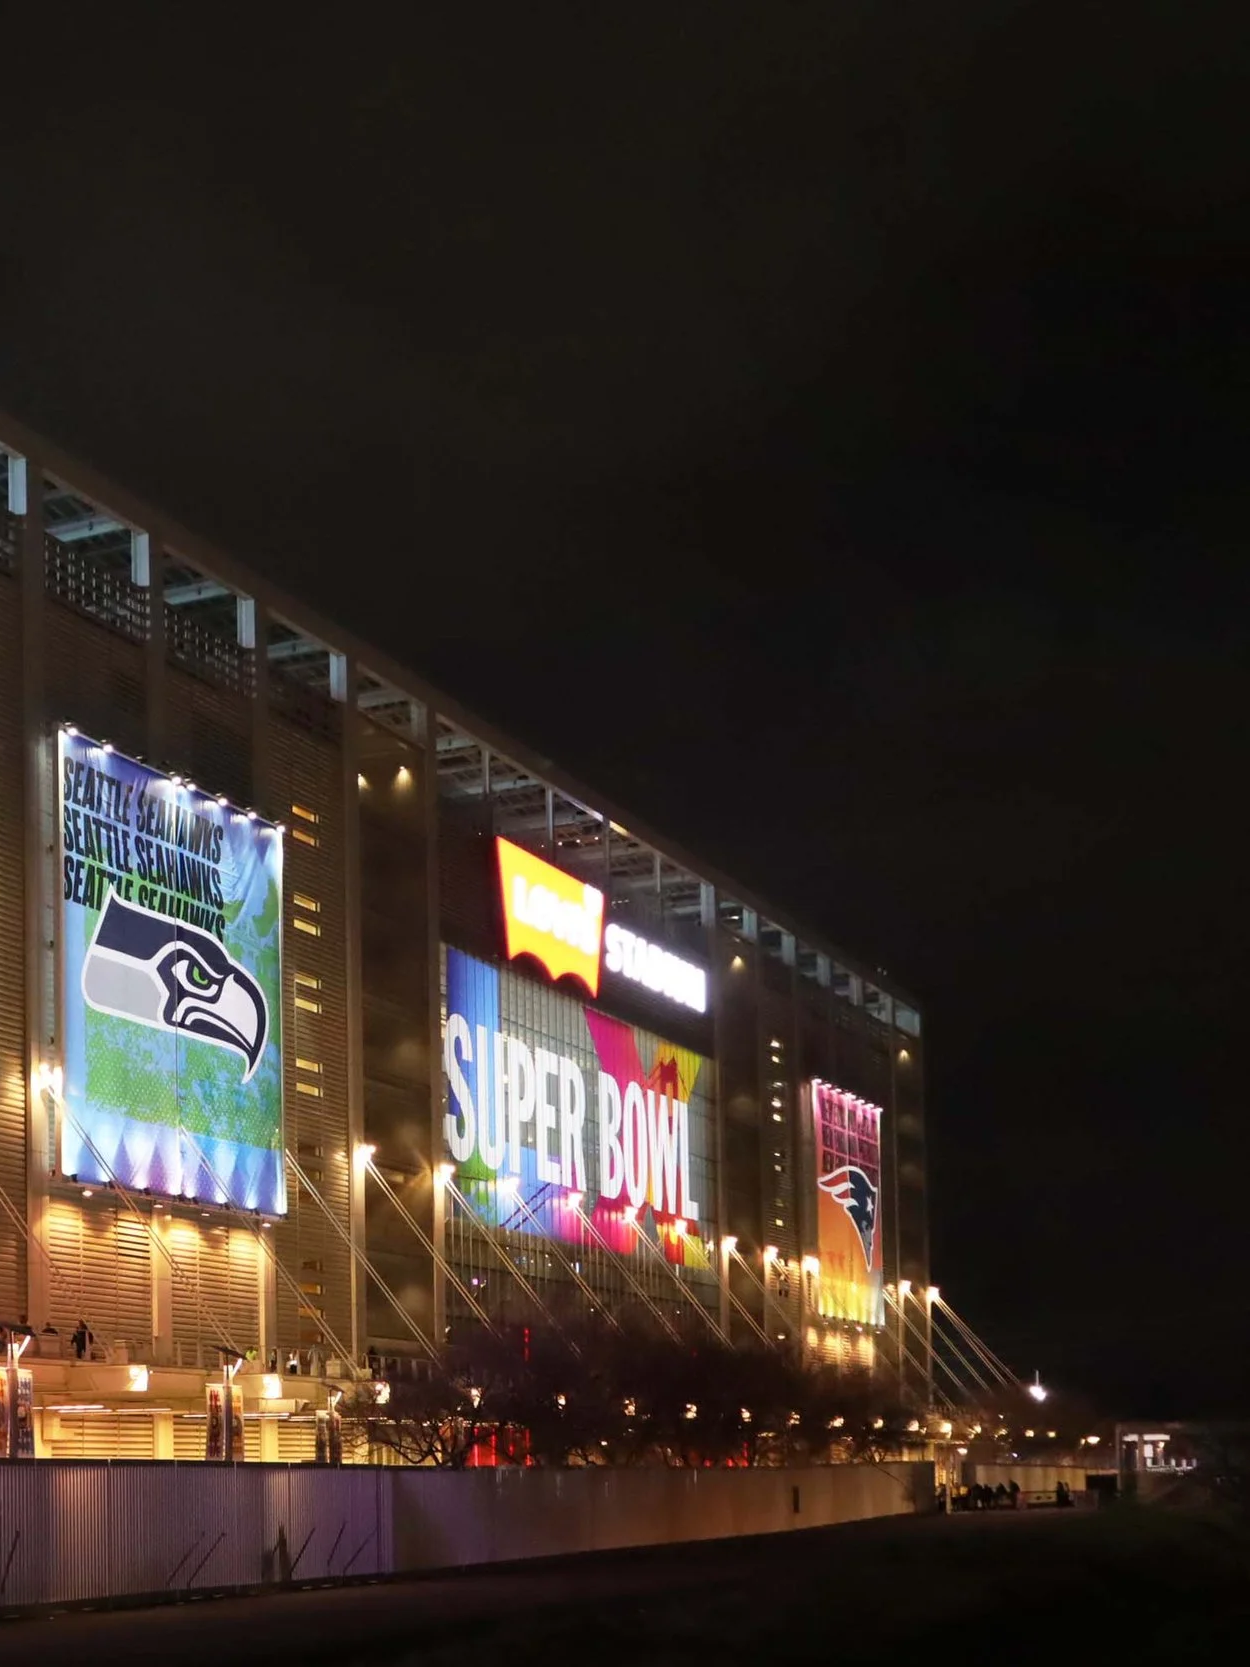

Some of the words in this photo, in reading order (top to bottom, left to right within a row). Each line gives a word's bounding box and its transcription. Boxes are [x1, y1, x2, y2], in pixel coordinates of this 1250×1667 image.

[63, 756, 133, 828] SEATTLE
[136, 786, 224, 865] SEAHAWKS
[63, 804, 134, 876] SEATTLE
[134, 834, 225, 911] SEAHAWKS
[442, 1012, 587, 1193] SUPER
[598, 1070, 699, 1221] BOWL
